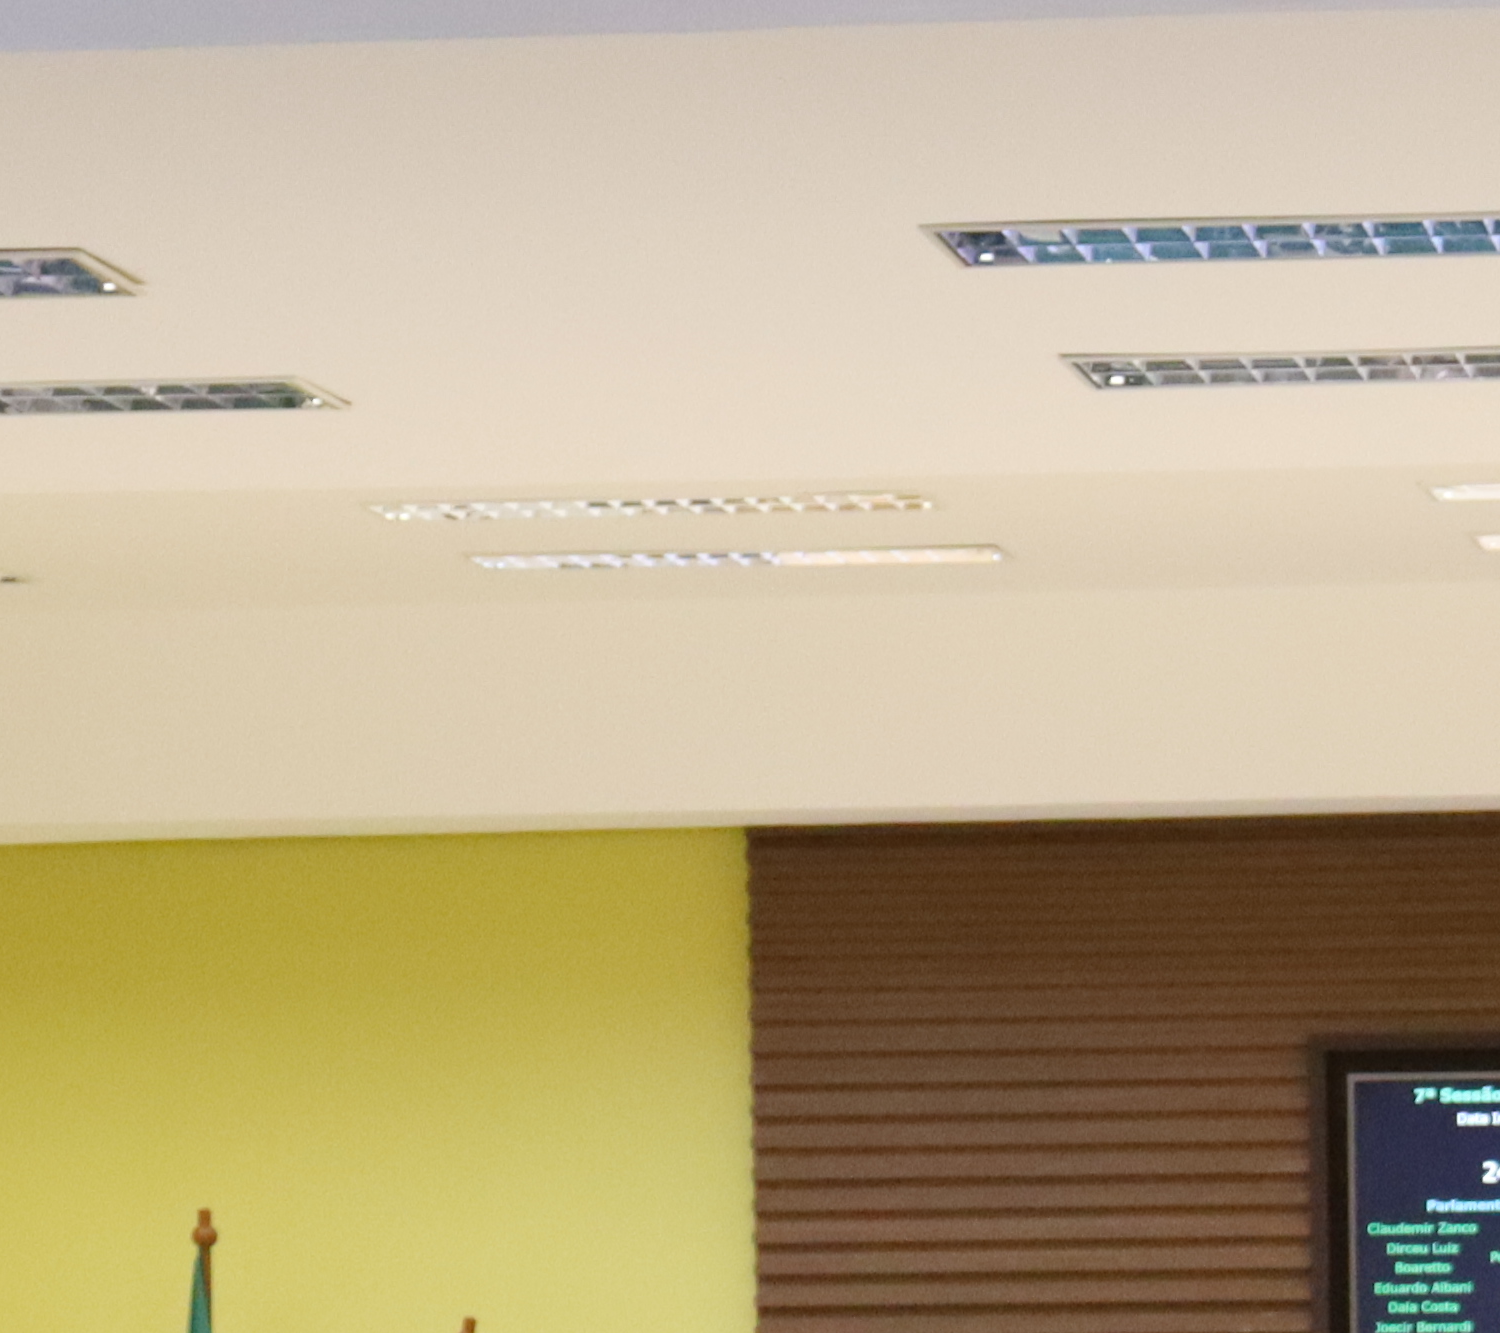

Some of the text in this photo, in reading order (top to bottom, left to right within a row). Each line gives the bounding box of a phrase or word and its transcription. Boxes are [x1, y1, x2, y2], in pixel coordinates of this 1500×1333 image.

[1456, 1112, 1490, 1127] Data
[1367, 1220, 1479, 1236] Claudemir Zanco
[1387, 1242, 1461, 1255] Dirceu Luiz
[1394, 1261, 1453, 1275] Boaretto
[1374, 1280, 1474, 1295] Eduardo Albani
[1421, 1300, 1461, 1314] Costa
[1416, 1320, 1474, 1333] Bernardi
